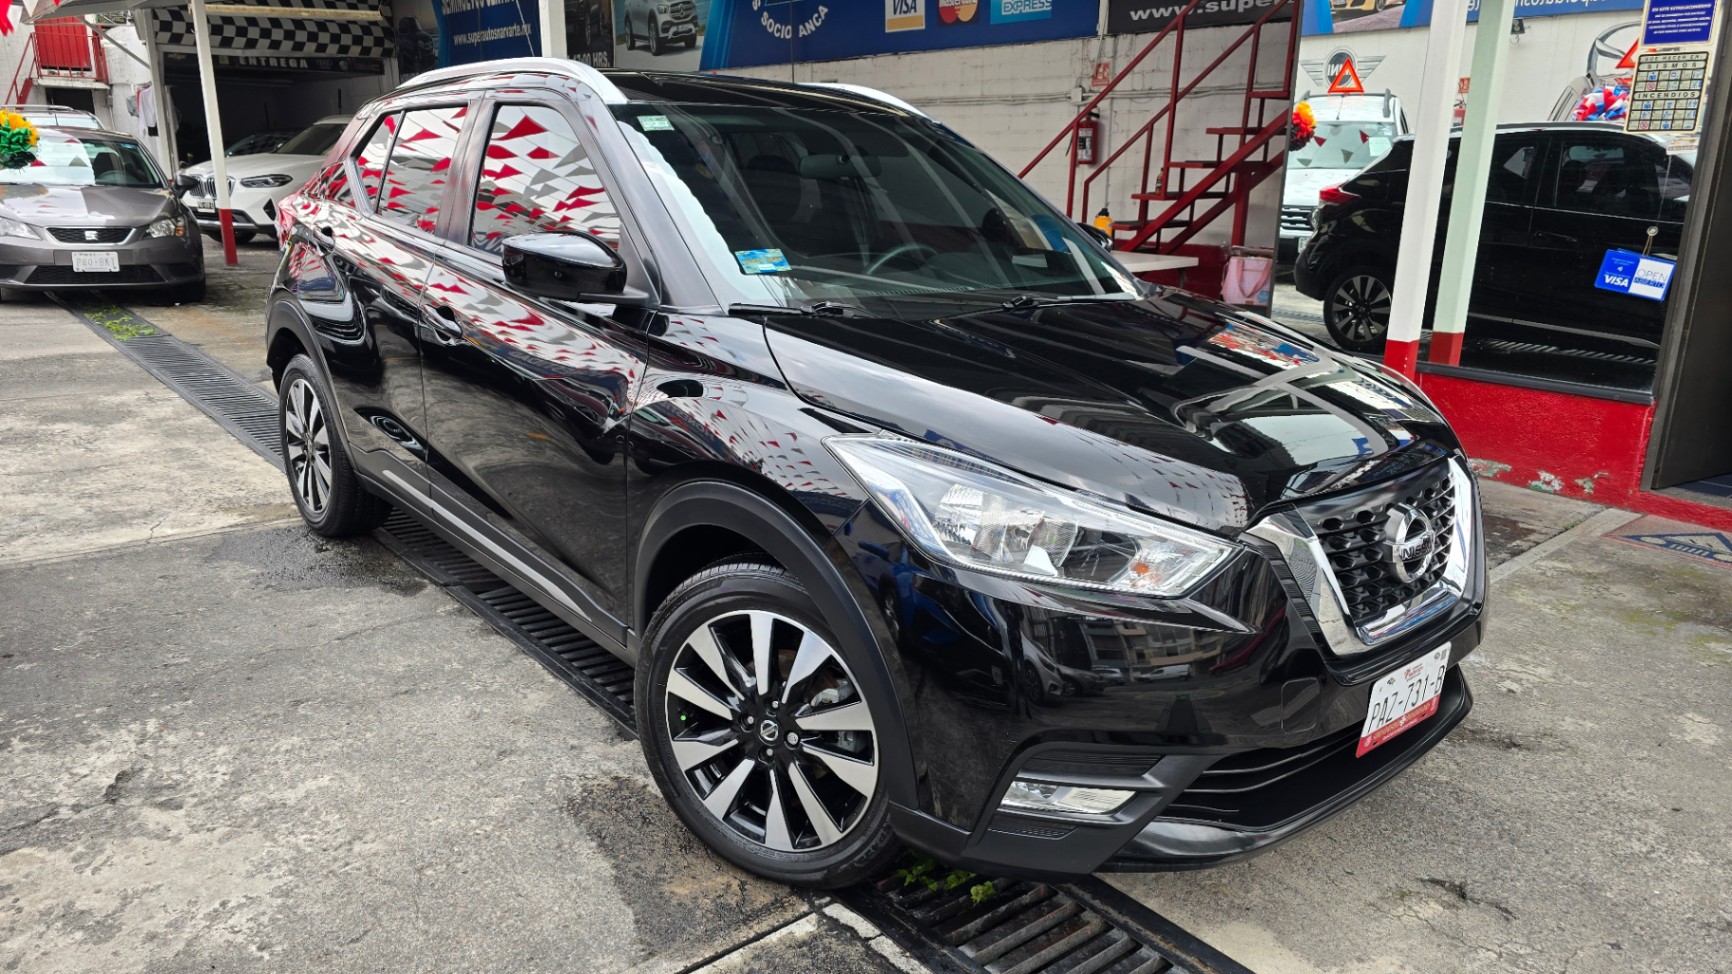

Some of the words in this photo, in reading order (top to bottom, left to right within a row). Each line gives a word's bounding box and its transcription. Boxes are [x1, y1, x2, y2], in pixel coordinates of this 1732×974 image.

[761, 11, 792, 39] SOCIO
[798, 5, 828, 38] ANCA
[239, 56, 308, 69] ENTREGA
[1638, 91, 1696, 99] INCENDIOS
[1604, 274, 1629, 288] VISA
[1637, 269, 1667, 282] OPEN
